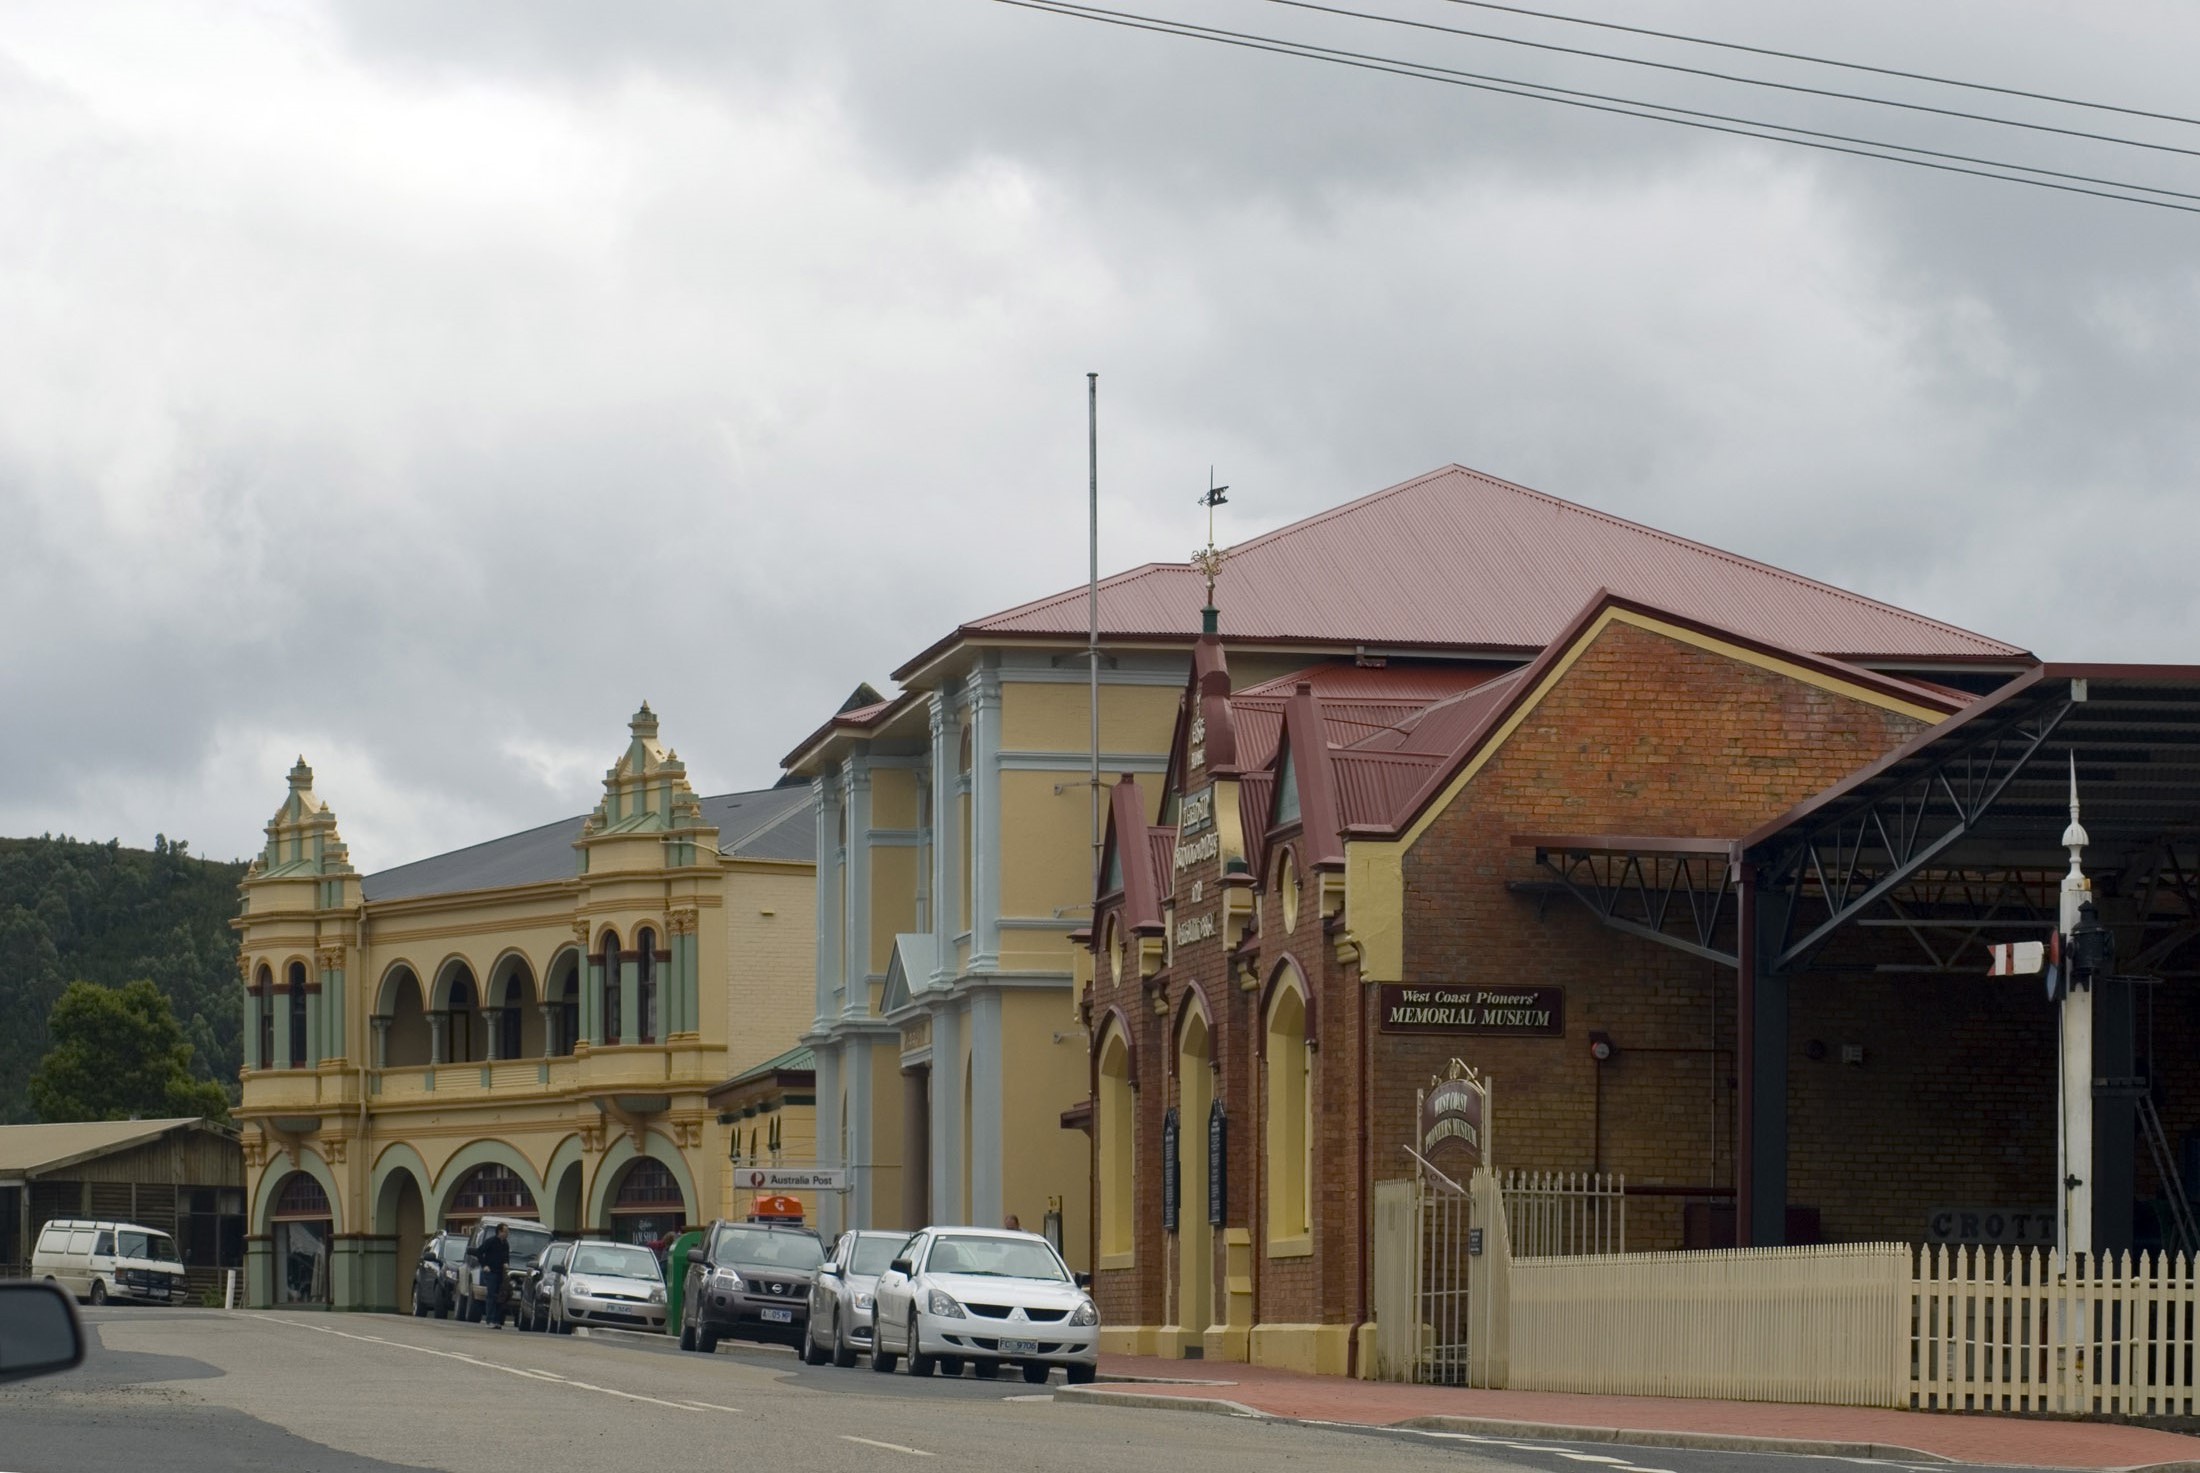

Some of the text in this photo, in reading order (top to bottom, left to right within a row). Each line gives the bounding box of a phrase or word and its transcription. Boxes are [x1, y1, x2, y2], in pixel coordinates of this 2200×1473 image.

[1402, 990, 1539, 1005] West Coast Pioneers'
[1389, 1007, 1551, 1026] MEMORIAL MUSEUM
[1434, 1091, 1468, 1118] WEST COAST
[770, 1175, 832, 1185] Australia Post
[1932, 1212, 2056, 1240] CROTT
